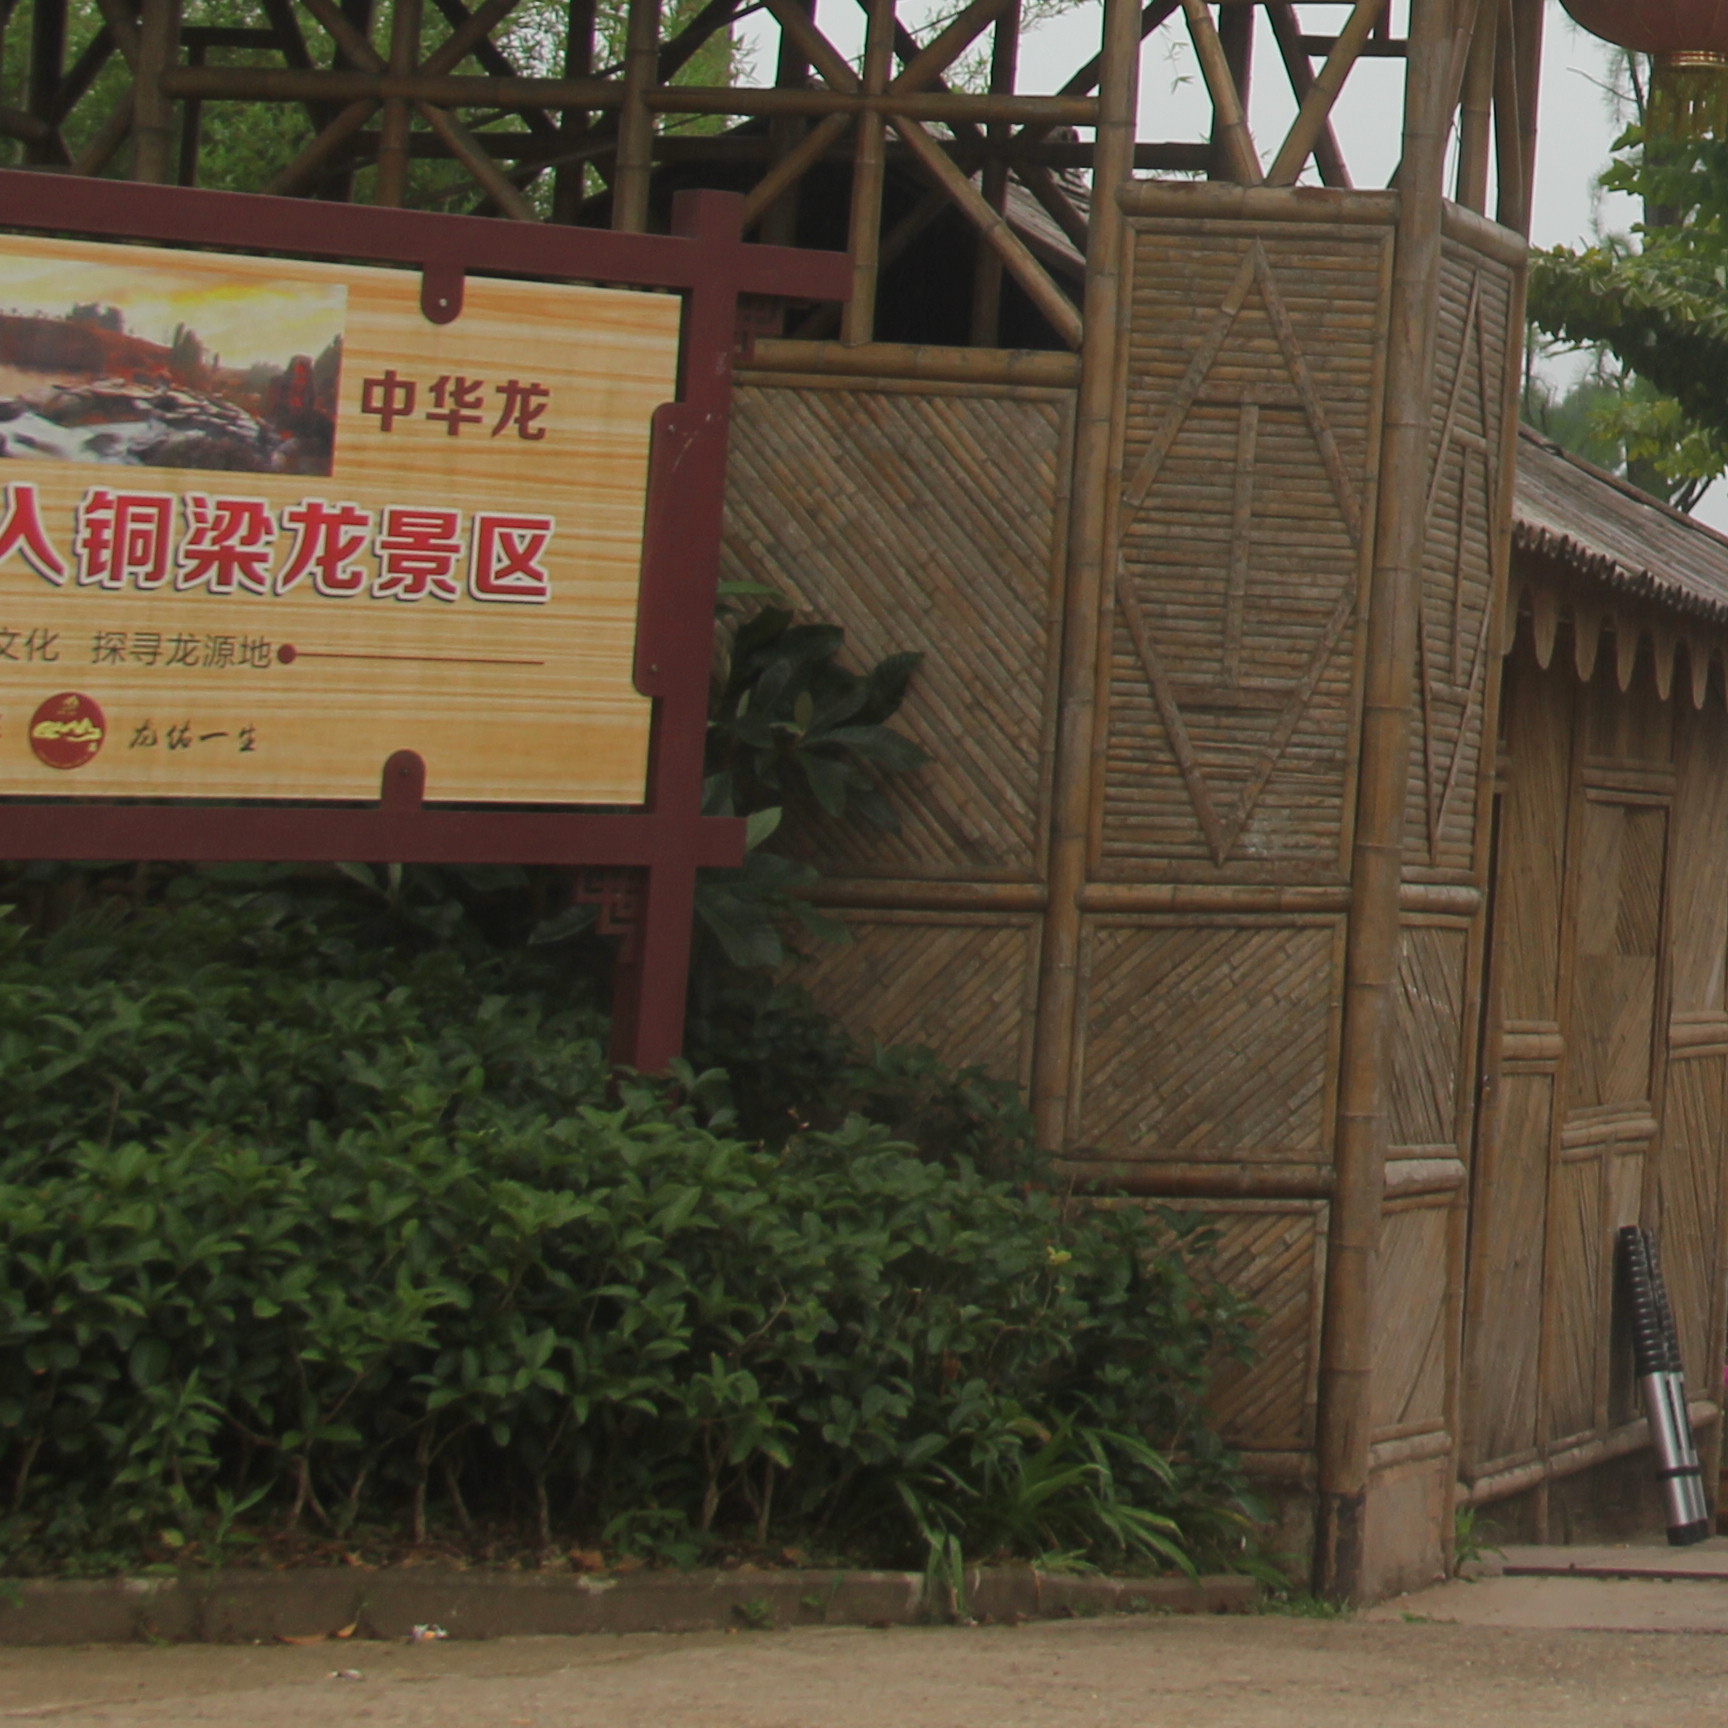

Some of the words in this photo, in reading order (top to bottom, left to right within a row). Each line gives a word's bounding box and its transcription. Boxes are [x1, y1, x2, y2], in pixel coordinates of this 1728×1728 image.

[362, 369, 550, 441] 中华龙
[91, 629, 272, 669] 探寻龙源地
